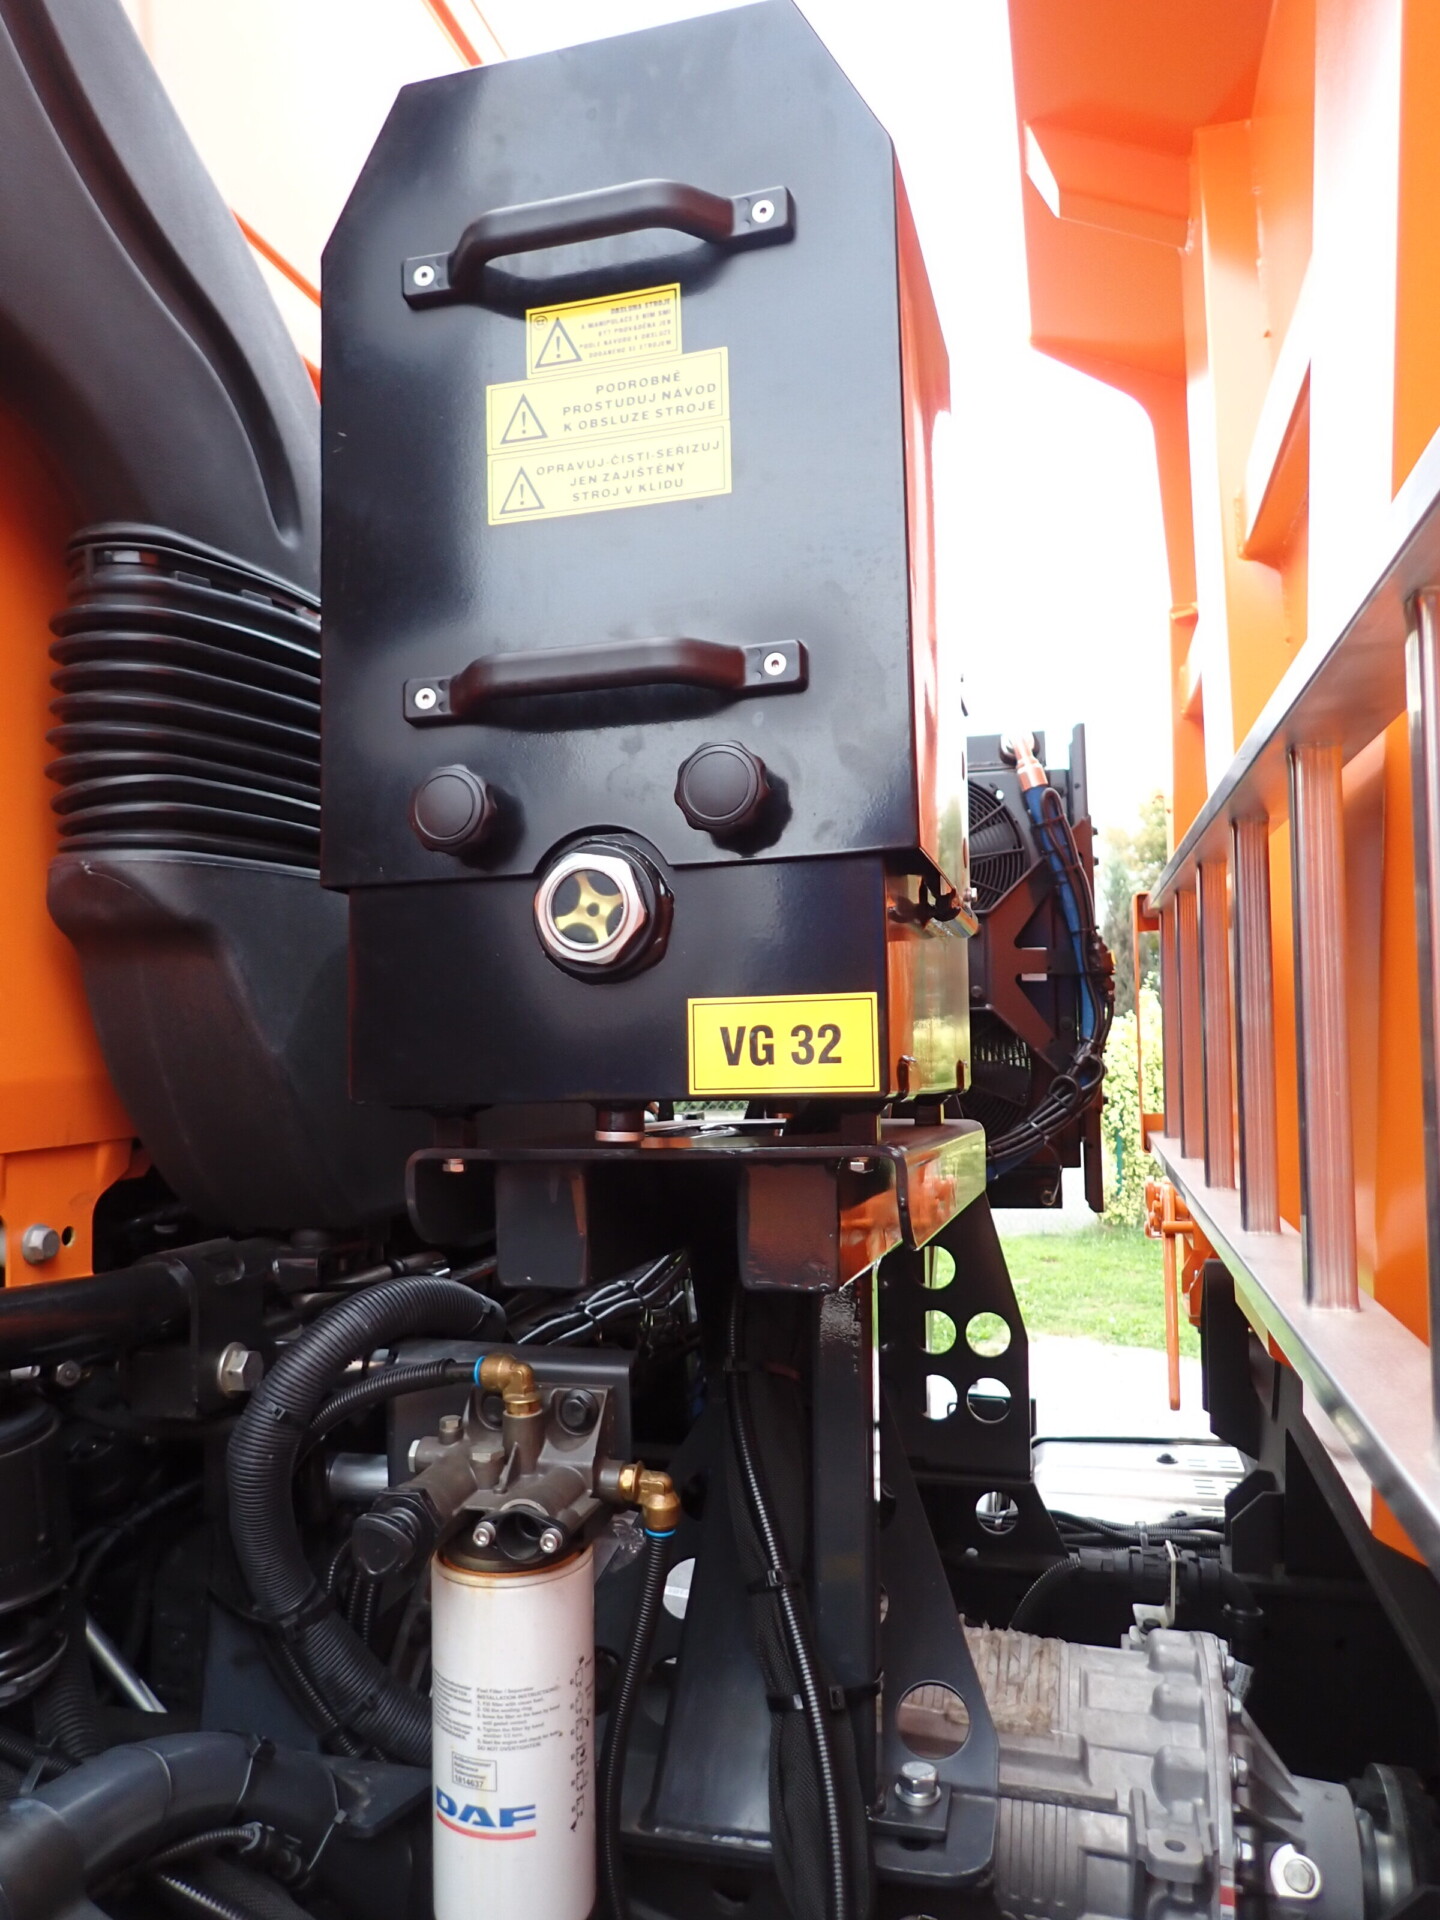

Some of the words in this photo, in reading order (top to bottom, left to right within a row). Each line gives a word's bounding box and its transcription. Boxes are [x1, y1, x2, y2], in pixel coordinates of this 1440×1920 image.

[563, 393, 656, 415] PROSTUDUJ
[564, 423, 572, 432] K
[578, 411, 649, 430] OBSLUZE
[656, 400, 716, 418] STROJE
[570, 475, 597, 486] JEN
[573, 488, 619, 502] STROJ
[625, 486, 632, 494] V
[639, 479, 684, 492] KLIDU
[720, 1025, 775, 1066] VG
[791, 1024, 842, 1065] 32
[436, 1786, 536, 1828] DAF
